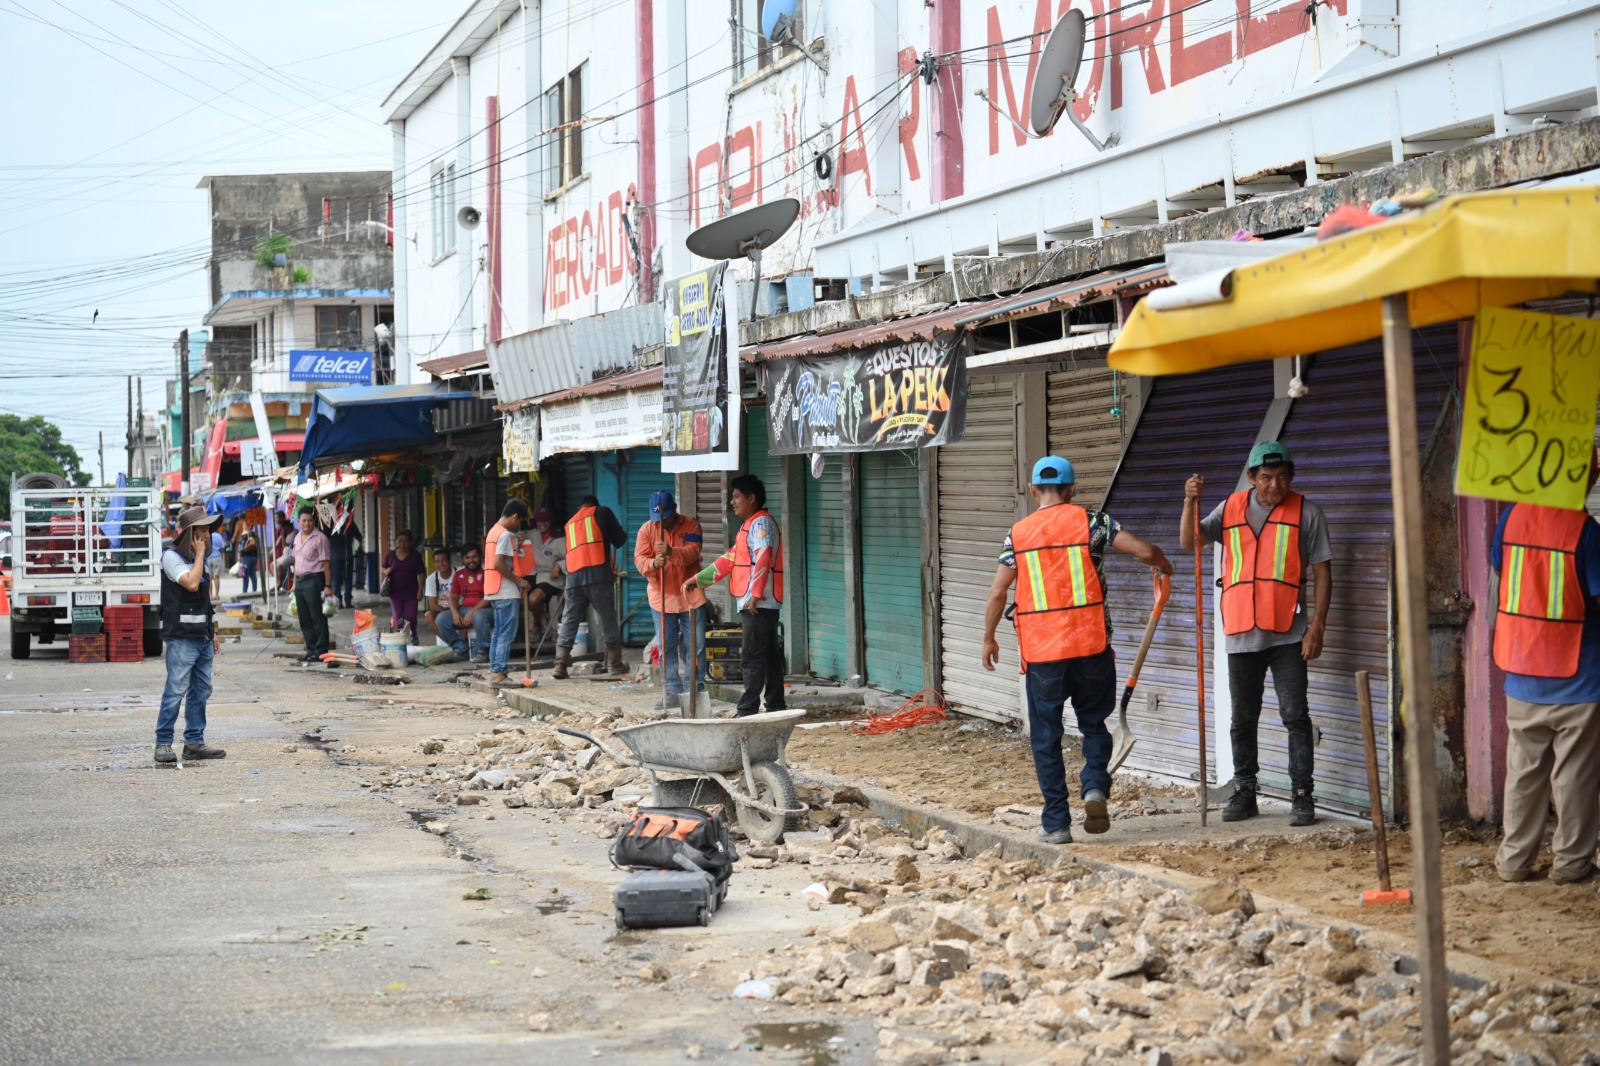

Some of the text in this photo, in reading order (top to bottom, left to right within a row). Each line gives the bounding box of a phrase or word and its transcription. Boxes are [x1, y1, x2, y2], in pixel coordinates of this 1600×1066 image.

[313, 355, 369, 374] telcel
[873, 341, 939, 377] QUESITOS
[868, 373, 898, 424] LA
[1478, 362, 1531, 436] 3
